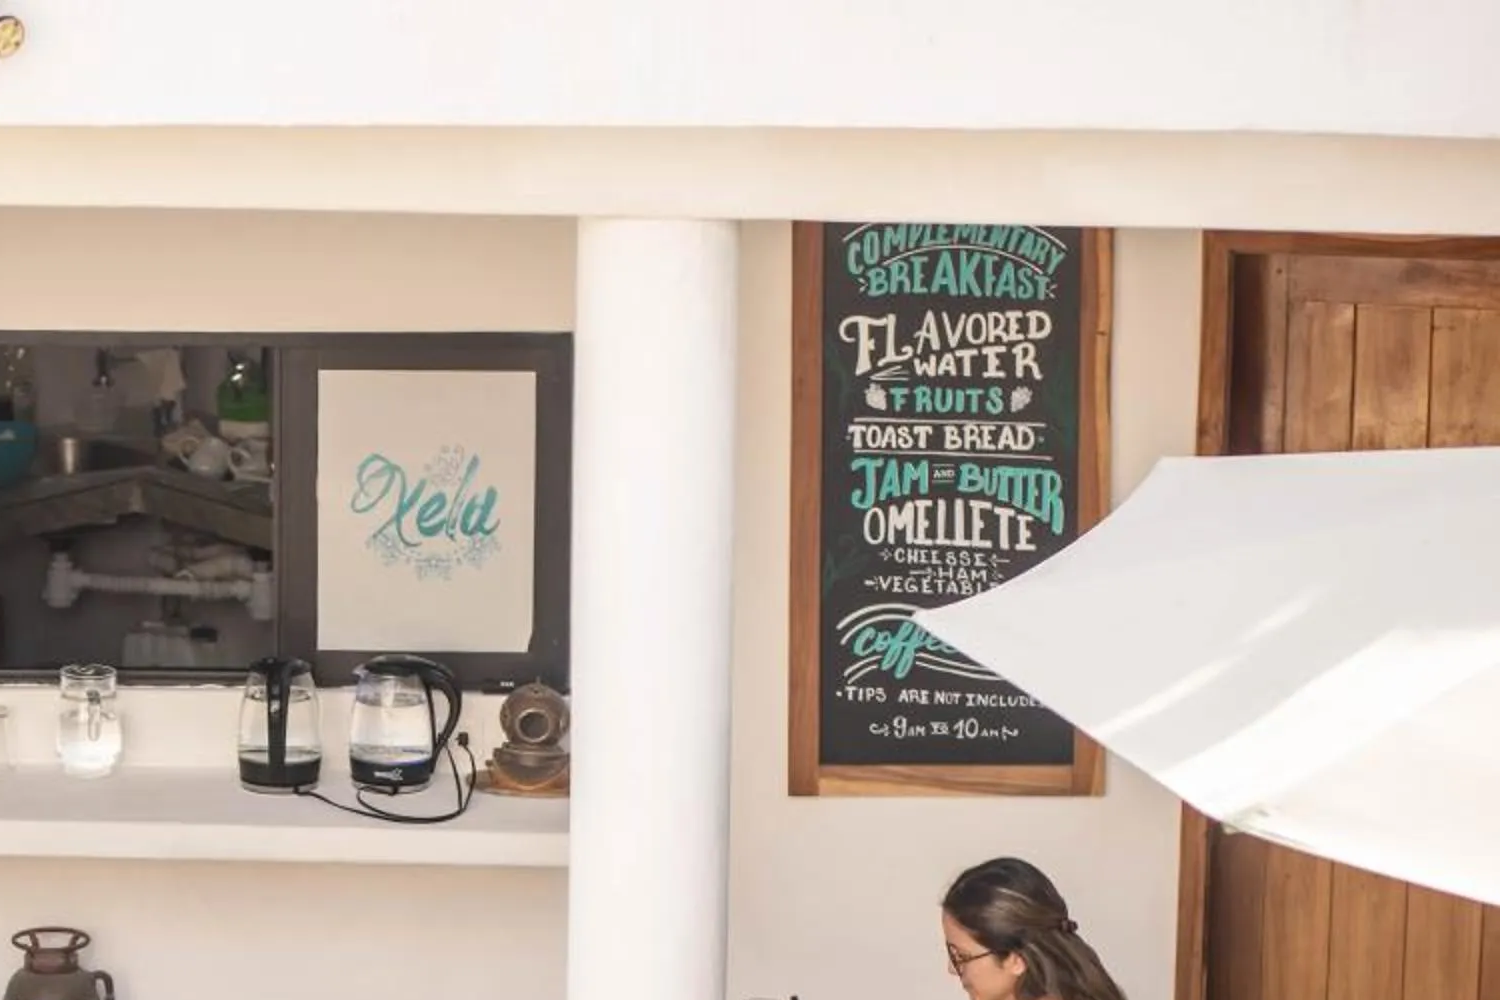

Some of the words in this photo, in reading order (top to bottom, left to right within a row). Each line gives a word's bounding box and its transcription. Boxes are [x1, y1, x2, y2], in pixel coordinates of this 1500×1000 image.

[866, 250, 1050, 300] BREAKFAST
[913, 342, 1043, 380] WATER
[888, 386, 1004, 415] FRUITS
[847, 424, 933, 449] TOAST
[943, 424, 1035, 450] BREAD
[851, 457, 929, 509] JAM
[863, 498, 1037, 551] OMELLETE
[938, 568, 987, 582] HAM
[844, 686, 887, 703] TIPS
[898, 689, 930, 704] ARE
[934, 691, 960, 705] NOT
[965, 692, 1043, 708] INCLUDE
